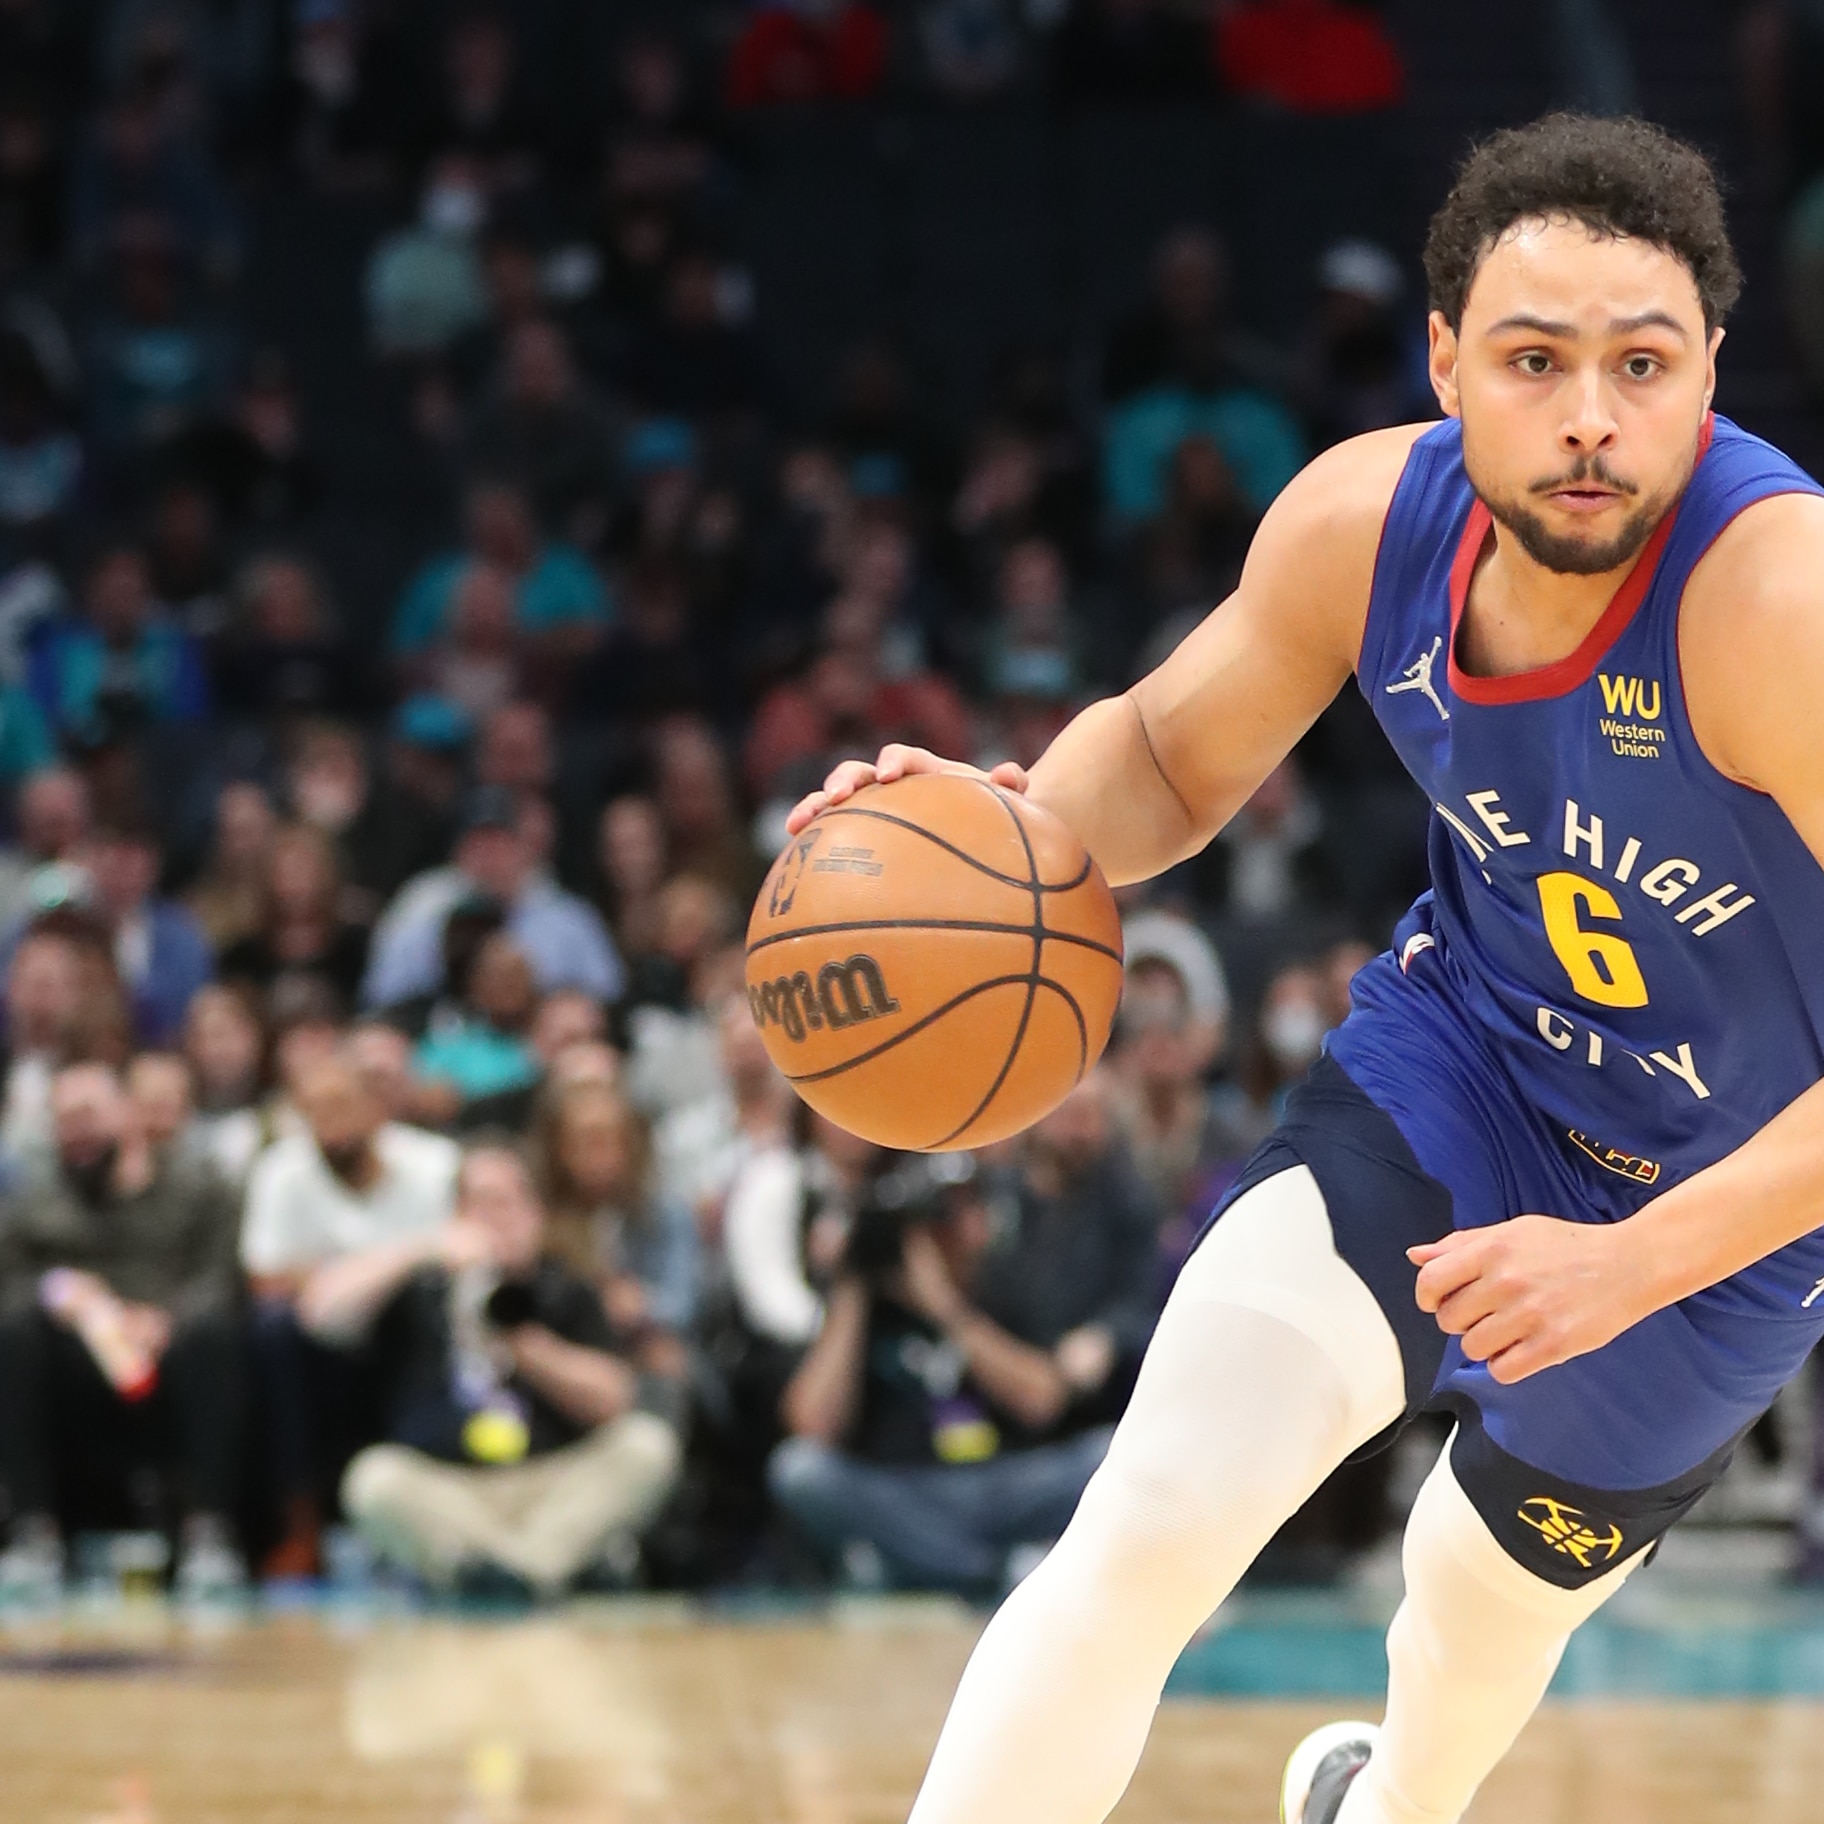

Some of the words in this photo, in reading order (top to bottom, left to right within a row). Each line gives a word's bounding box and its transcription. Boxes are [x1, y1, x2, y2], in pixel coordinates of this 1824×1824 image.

[1597, 673, 1661, 720] WU
[1599, 718, 1666, 742] Western
[1611, 738, 1660, 758] Union
[1562, 798, 1756, 938] HIGH
[1536, 870, 1650, 1009] 6
